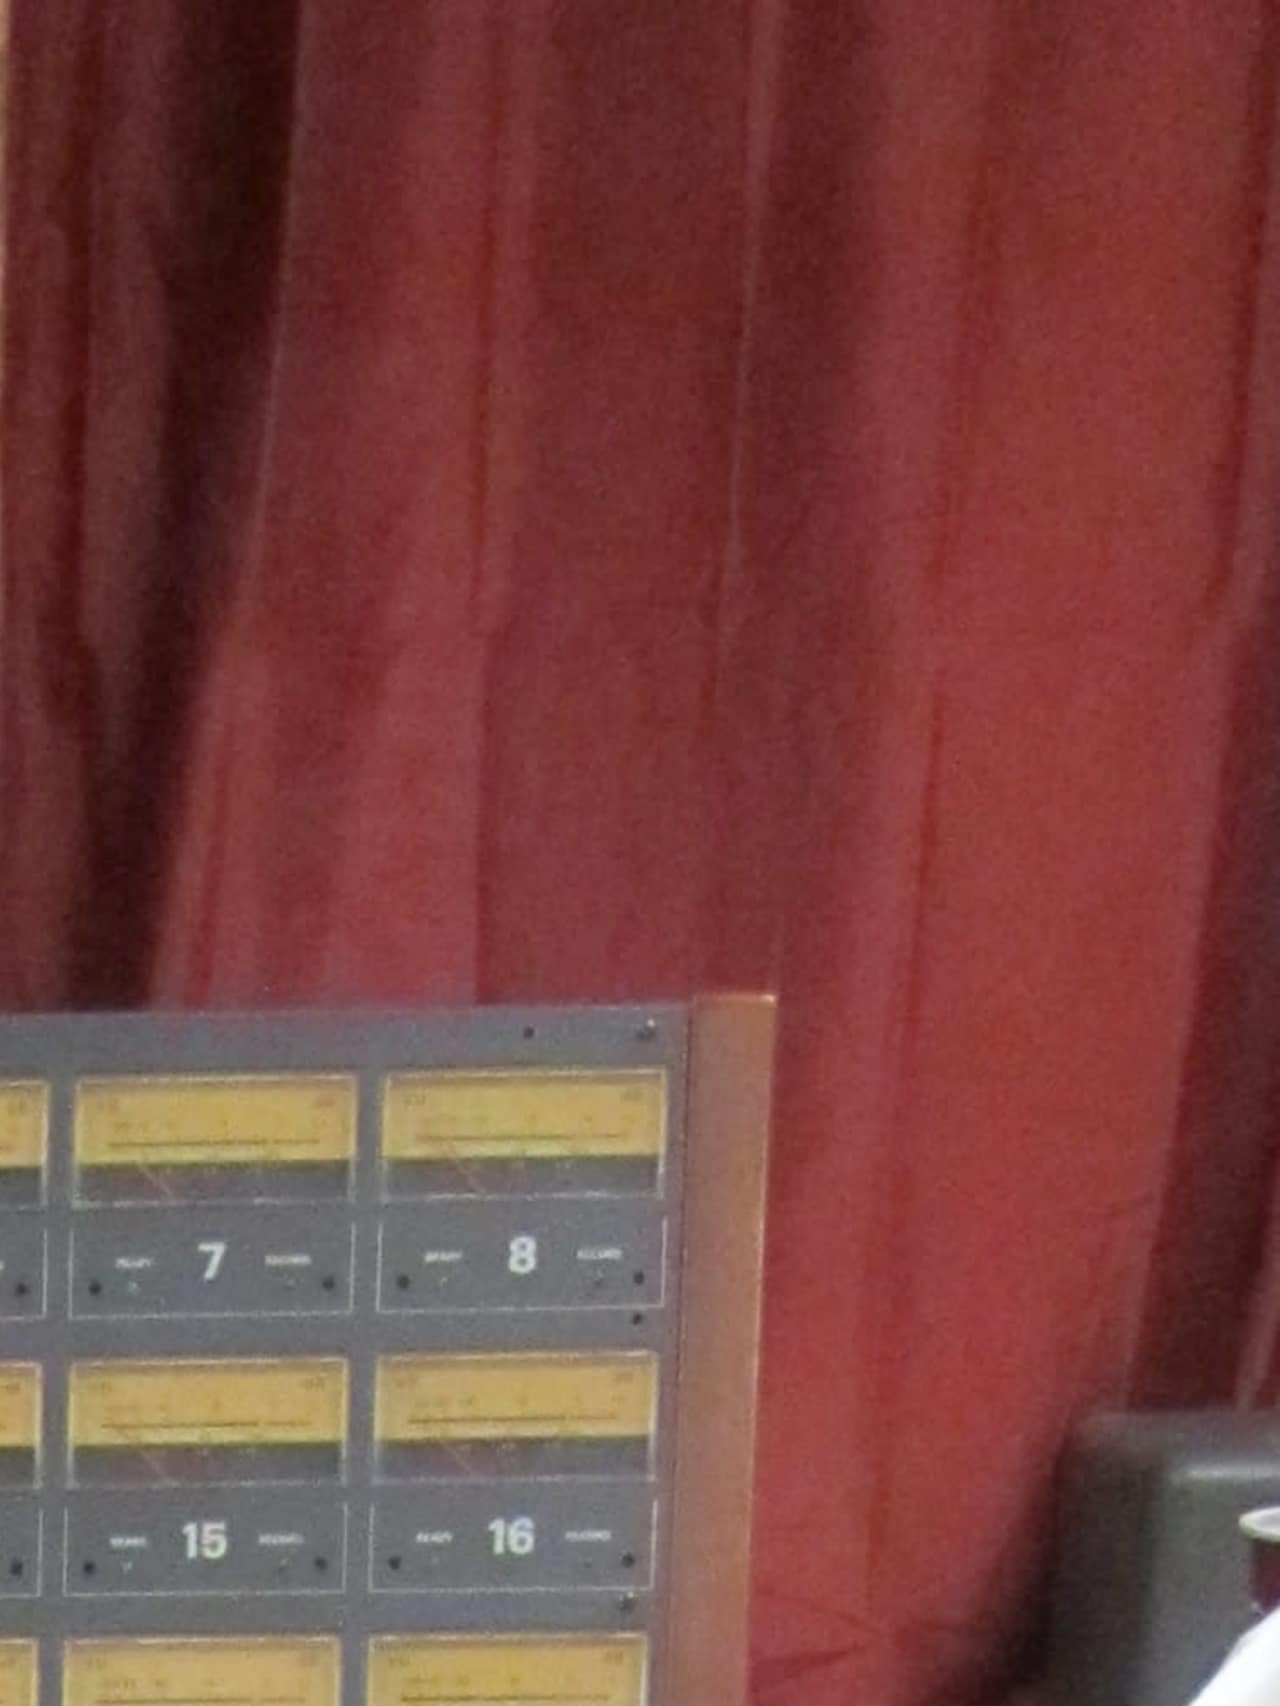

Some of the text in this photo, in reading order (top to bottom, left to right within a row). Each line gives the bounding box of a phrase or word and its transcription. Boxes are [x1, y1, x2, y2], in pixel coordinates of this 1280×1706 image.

[197, 1240, 227, 1280] 7
[507, 1234, 538, 1275] 8
[182, 1521, 229, 1560] 15
[487, 1516, 536, 1556] 16
